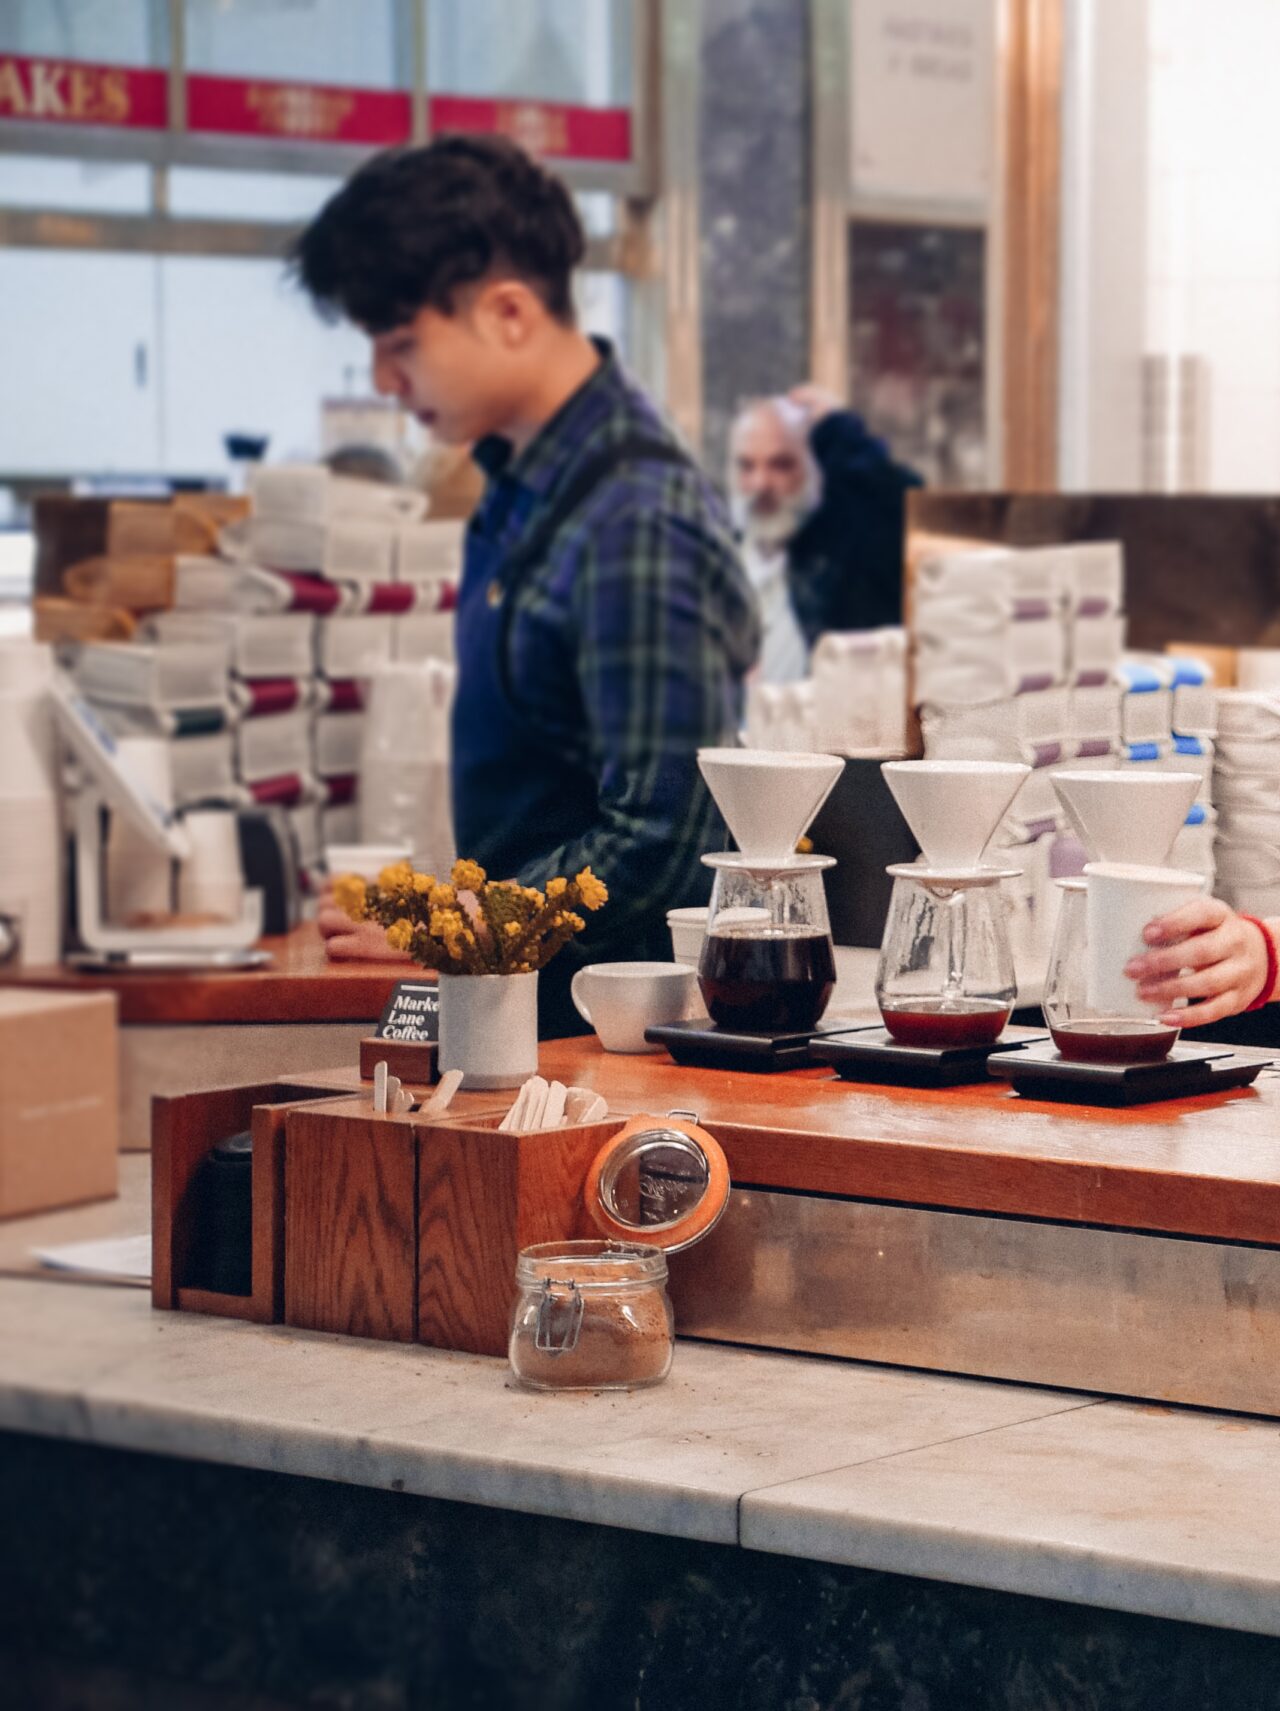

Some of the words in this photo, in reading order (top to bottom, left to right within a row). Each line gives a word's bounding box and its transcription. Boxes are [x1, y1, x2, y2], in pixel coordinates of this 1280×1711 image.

[393, 994, 439, 1012] Marke
[388, 1009, 425, 1026] Lane
[382, 1024, 429, 1041] Coffee
